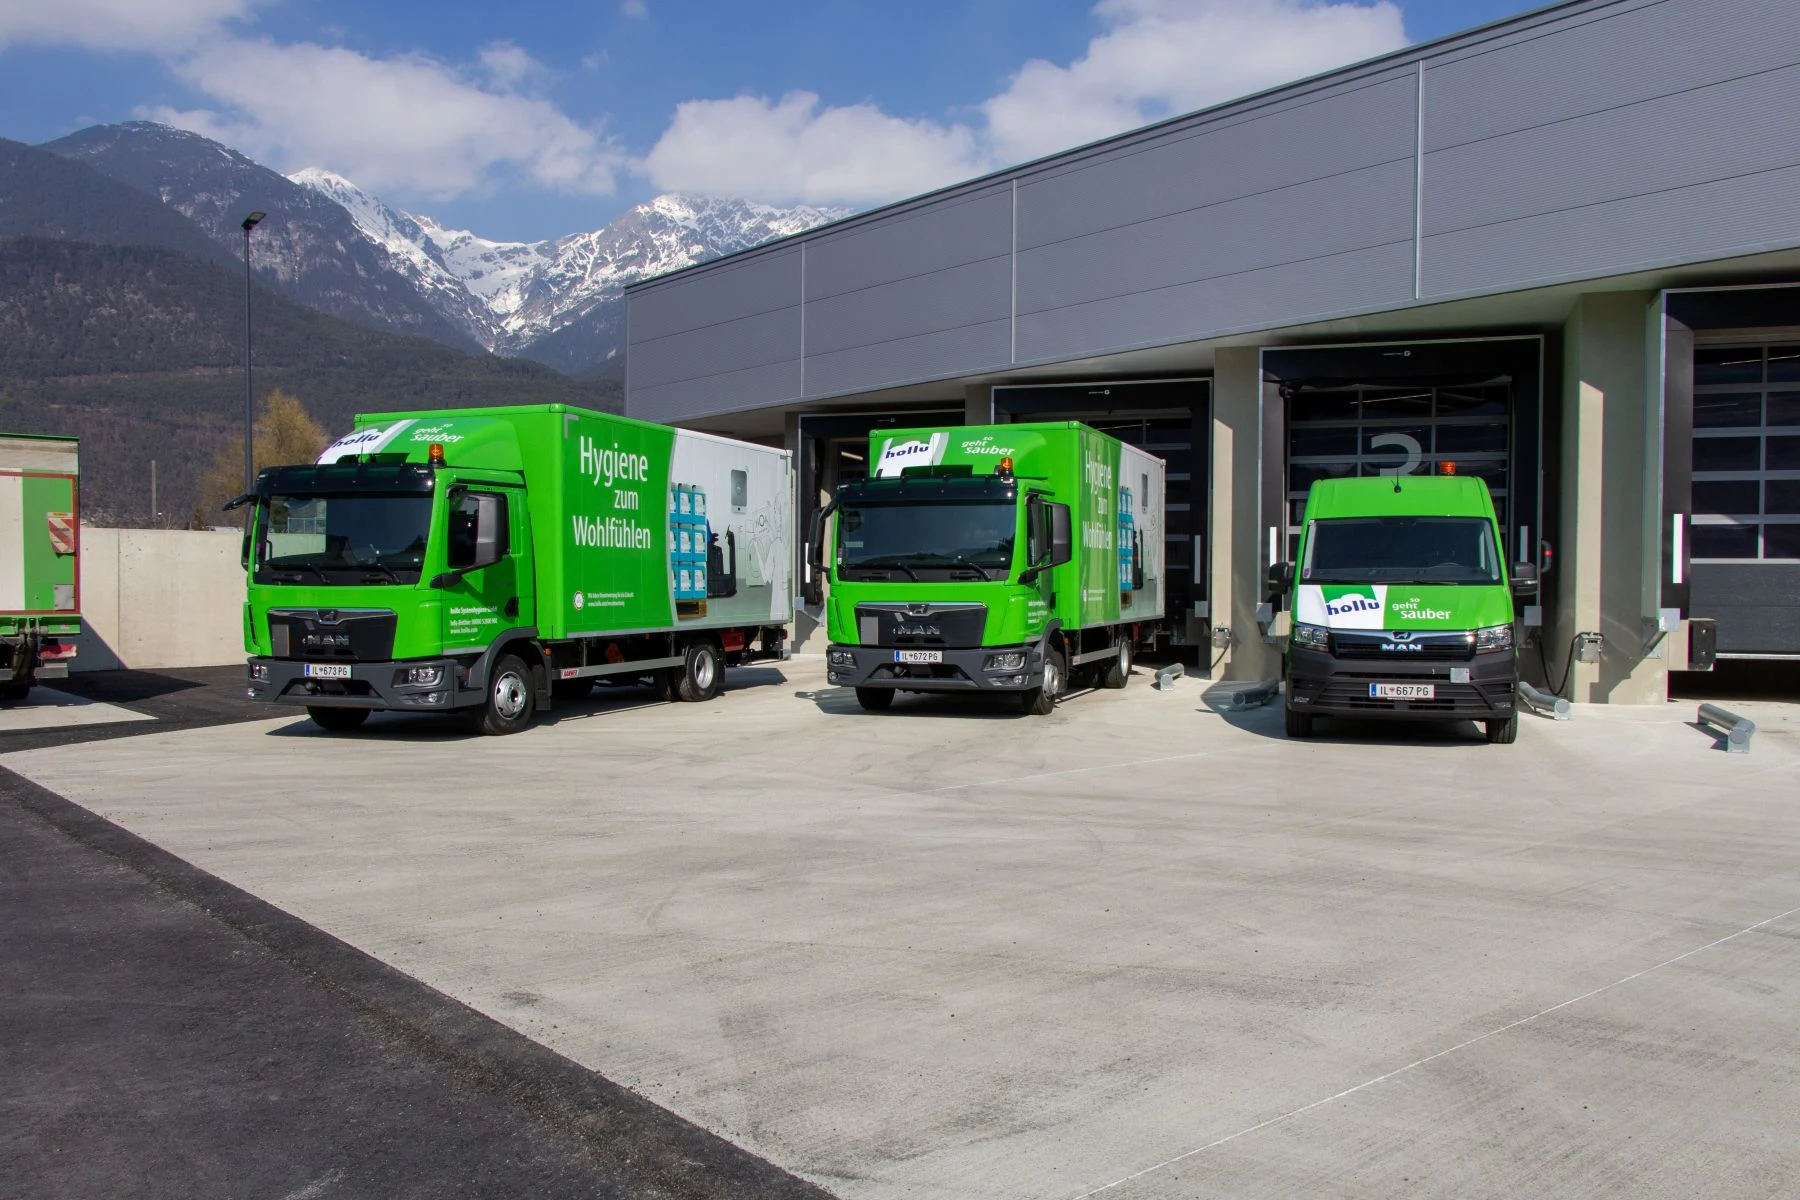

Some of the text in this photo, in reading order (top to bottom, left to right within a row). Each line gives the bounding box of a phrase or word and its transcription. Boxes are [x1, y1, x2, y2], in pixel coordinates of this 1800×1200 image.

[413, 427, 442, 435] geht
[332, 433, 379, 448] hollu
[410, 433, 464, 443] sauber
[961, 440, 988, 448] geht
[885, 445, 929, 459] hollu
[964, 445, 1016, 456] sauber
[580, 435, 648, 487] Hygiene
[1085, 449, 1112, 495] Hygiene
[614, 489, 639, 510] zum
[572, 515, 651, 549] Wohlfühlen
[1326, 600, 1380, 616] hollu
[1392, 602, 1418, 611] geht
[1401, 608, 1452, 620] sauber
[307, 634, 350, 646] MAN
[1381, 643, 1422, 652] MAN
[1396, 686, 1414, 696] 667
